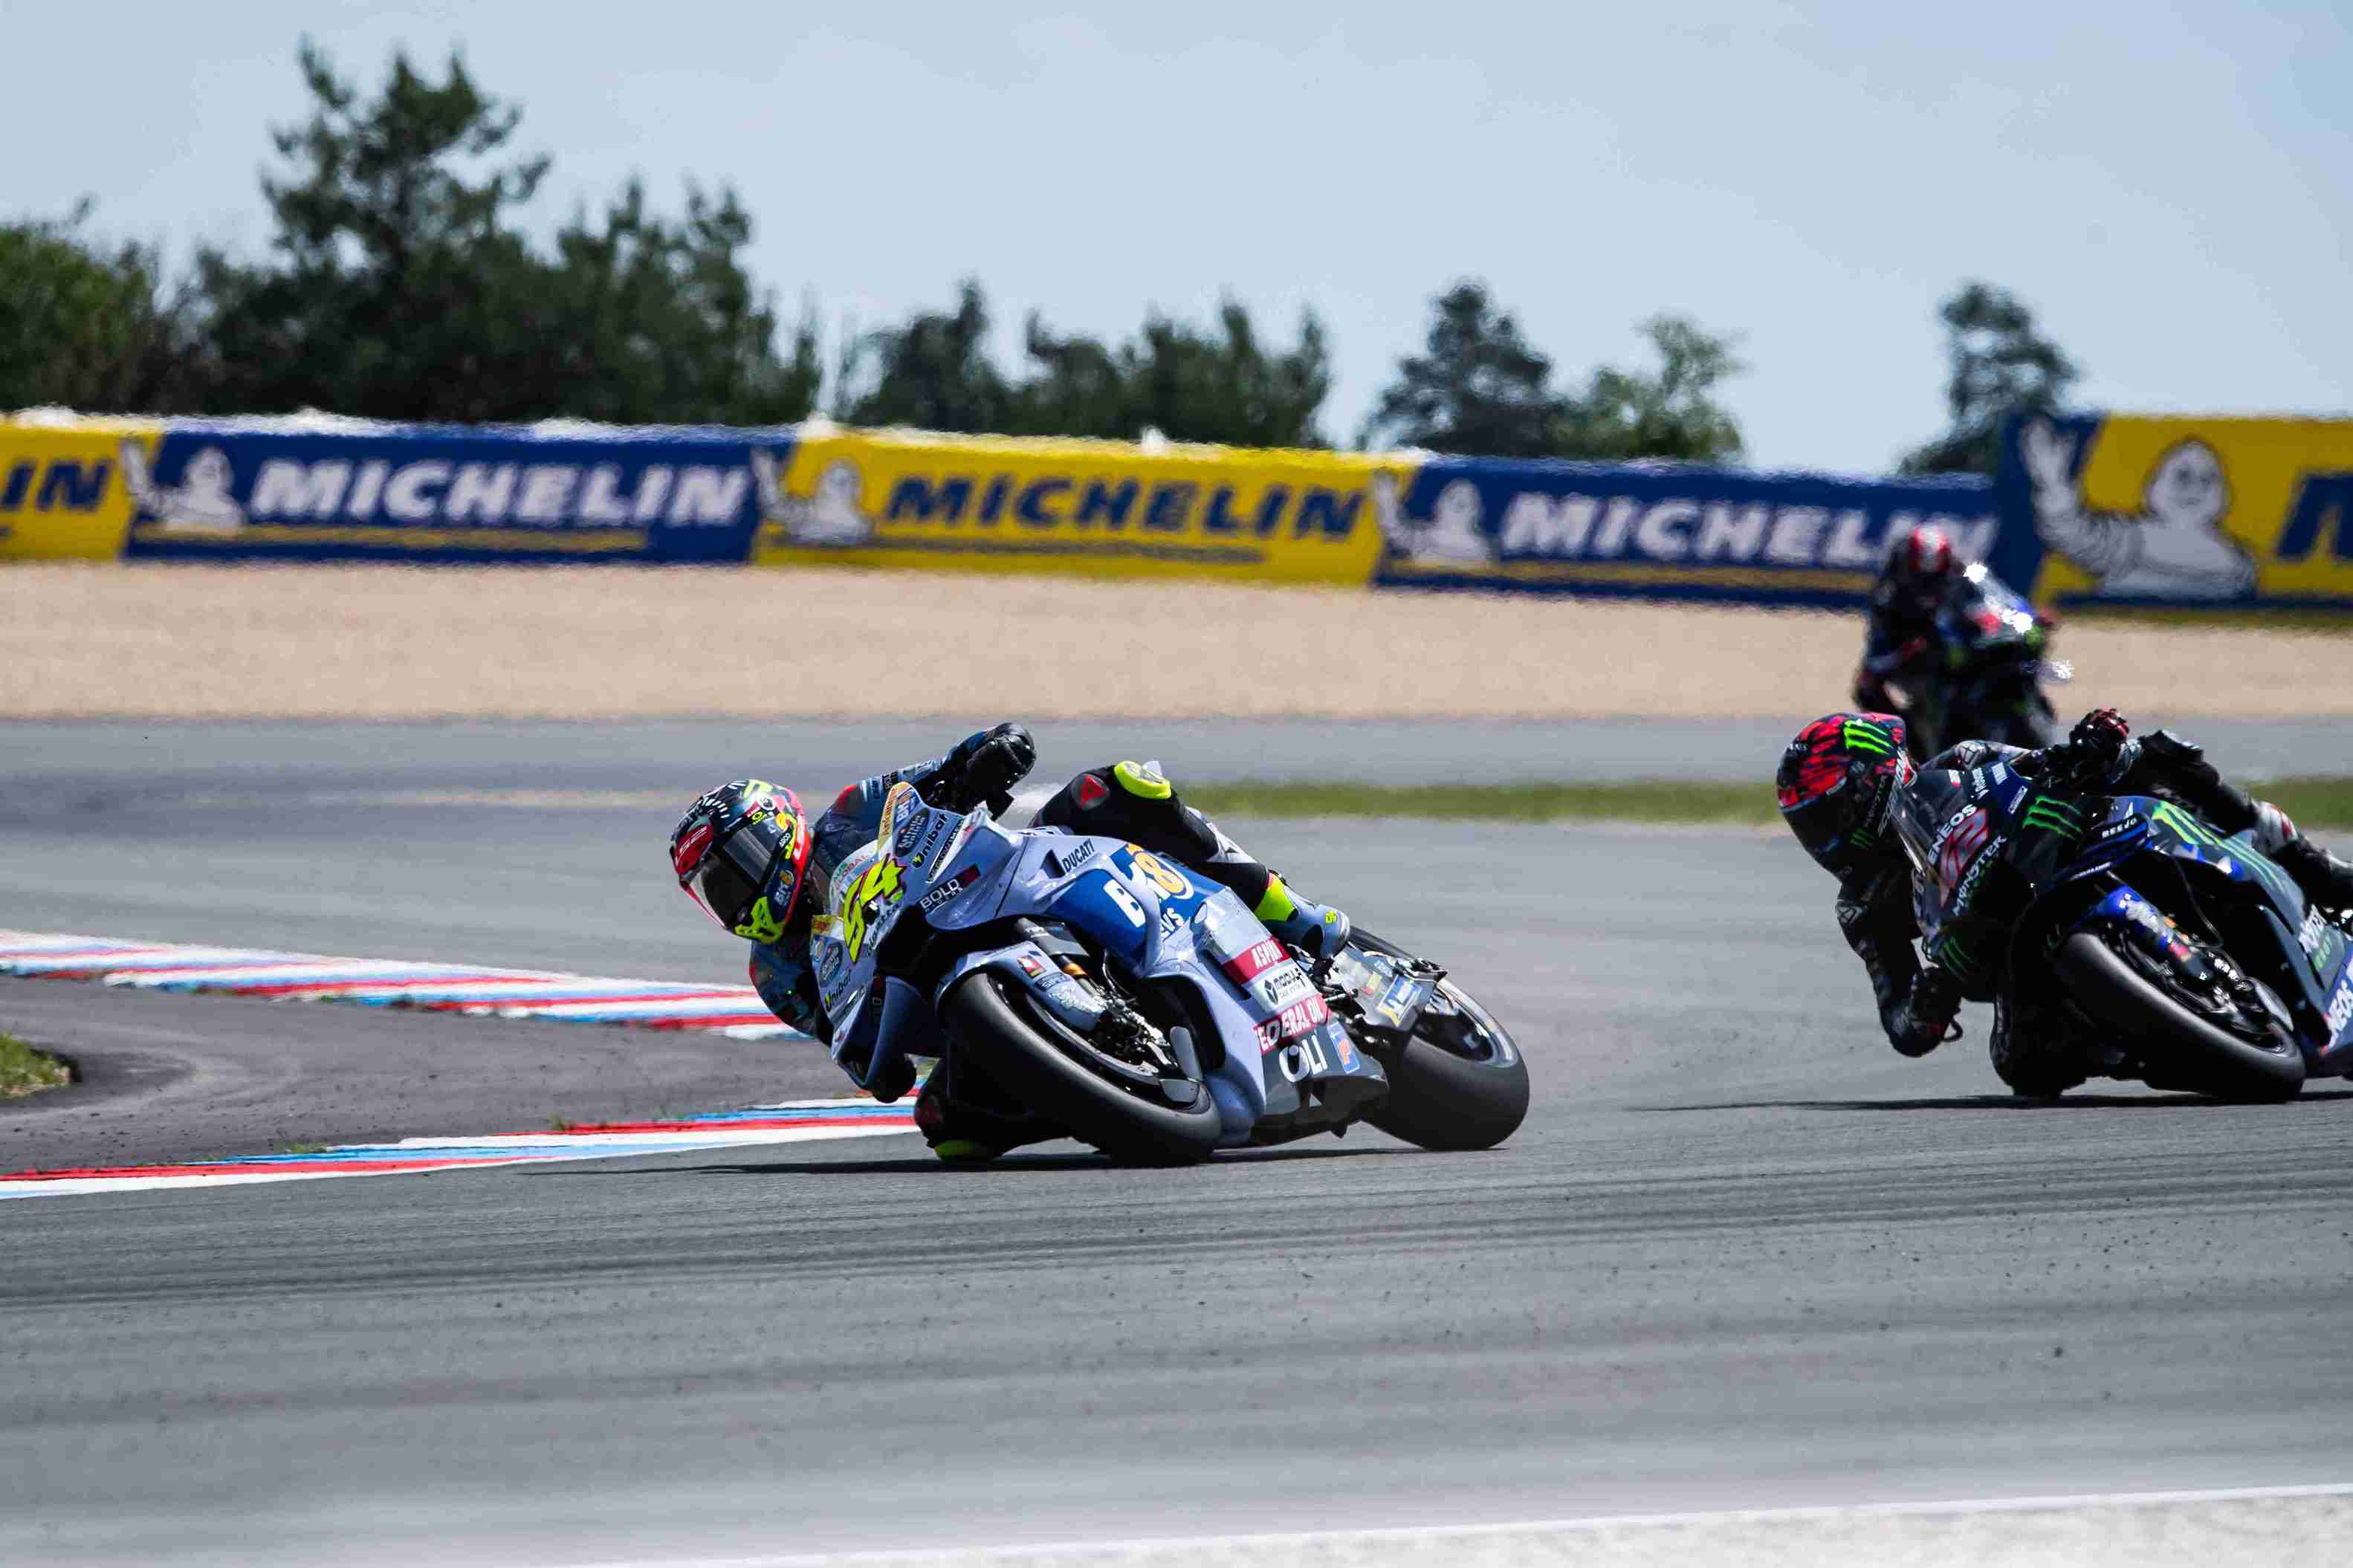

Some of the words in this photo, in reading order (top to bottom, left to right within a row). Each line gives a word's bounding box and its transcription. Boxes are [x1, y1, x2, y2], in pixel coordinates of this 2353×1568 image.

[250, 458, 746, 528] MICHELIN
[883, 473, 1363, 538] MICHELIN
[1063, 838, 1095, 872] DUCATI
[1927, 803, 1978, 865] ENEOS
[919, 878, 959, 909] BOLD
